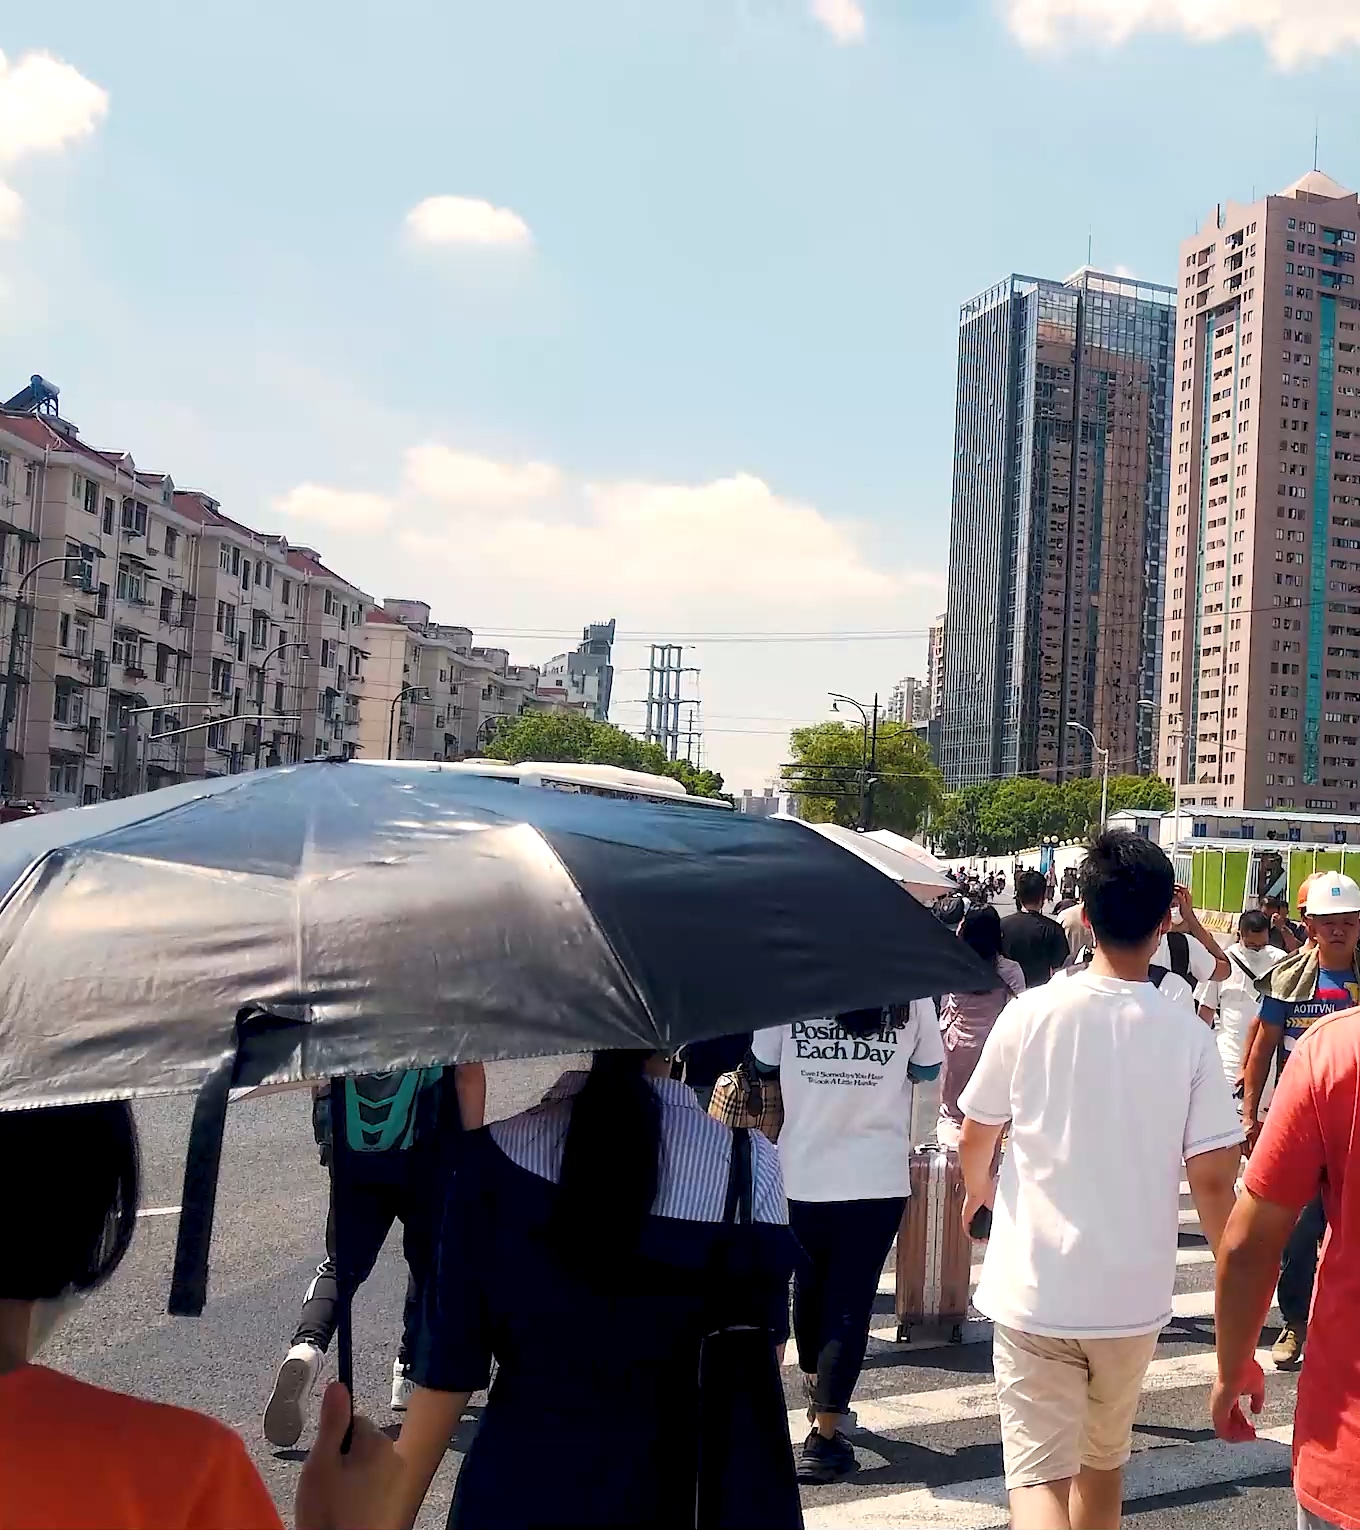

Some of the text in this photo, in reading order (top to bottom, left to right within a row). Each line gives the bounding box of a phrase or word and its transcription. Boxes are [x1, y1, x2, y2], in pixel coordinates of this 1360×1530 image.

[790, 1020, 876, 1041] Positi
[796, 1040, 895, 1066] Each Day
